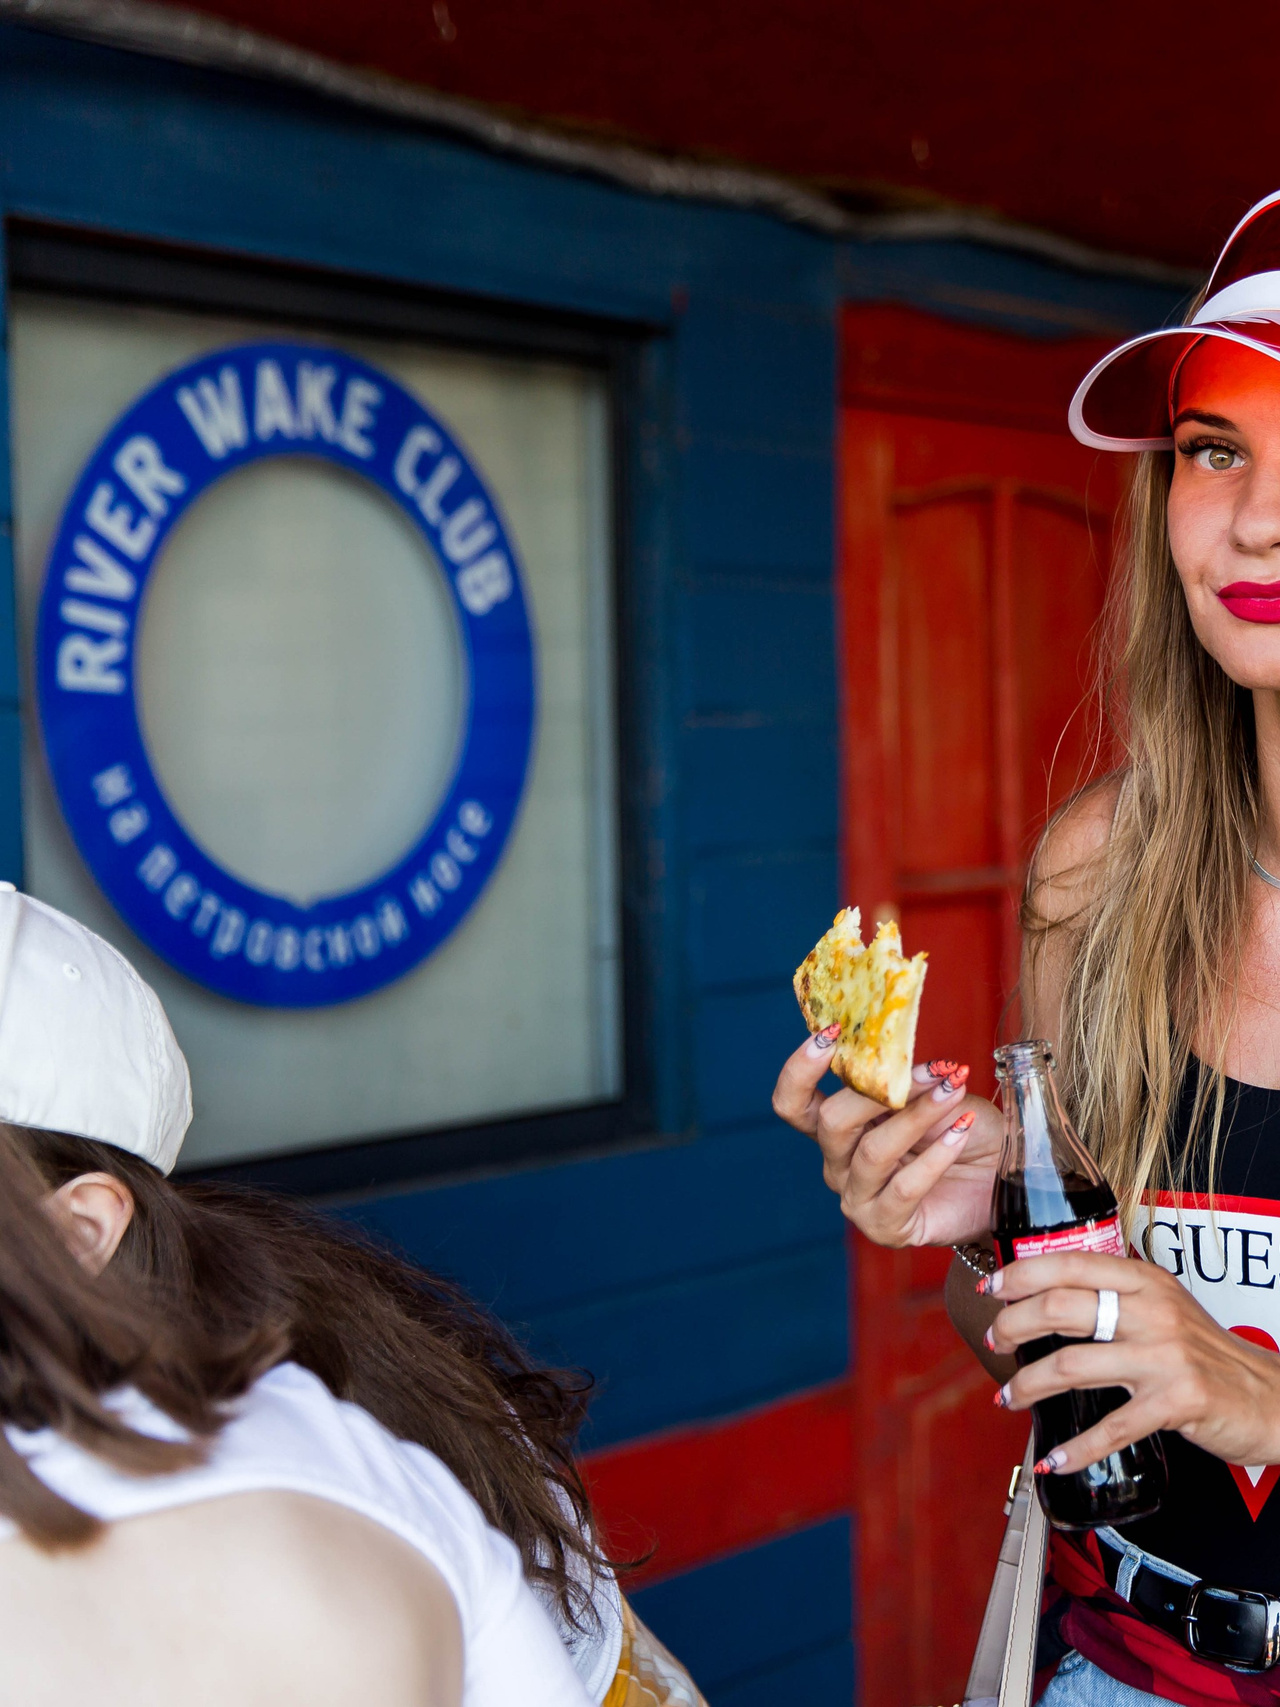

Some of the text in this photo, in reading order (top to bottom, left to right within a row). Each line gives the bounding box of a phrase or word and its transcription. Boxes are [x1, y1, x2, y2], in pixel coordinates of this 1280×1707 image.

[57, 359, 513, 695] RIVER WAKE CLUB
[92, 762, 149, 846] на
